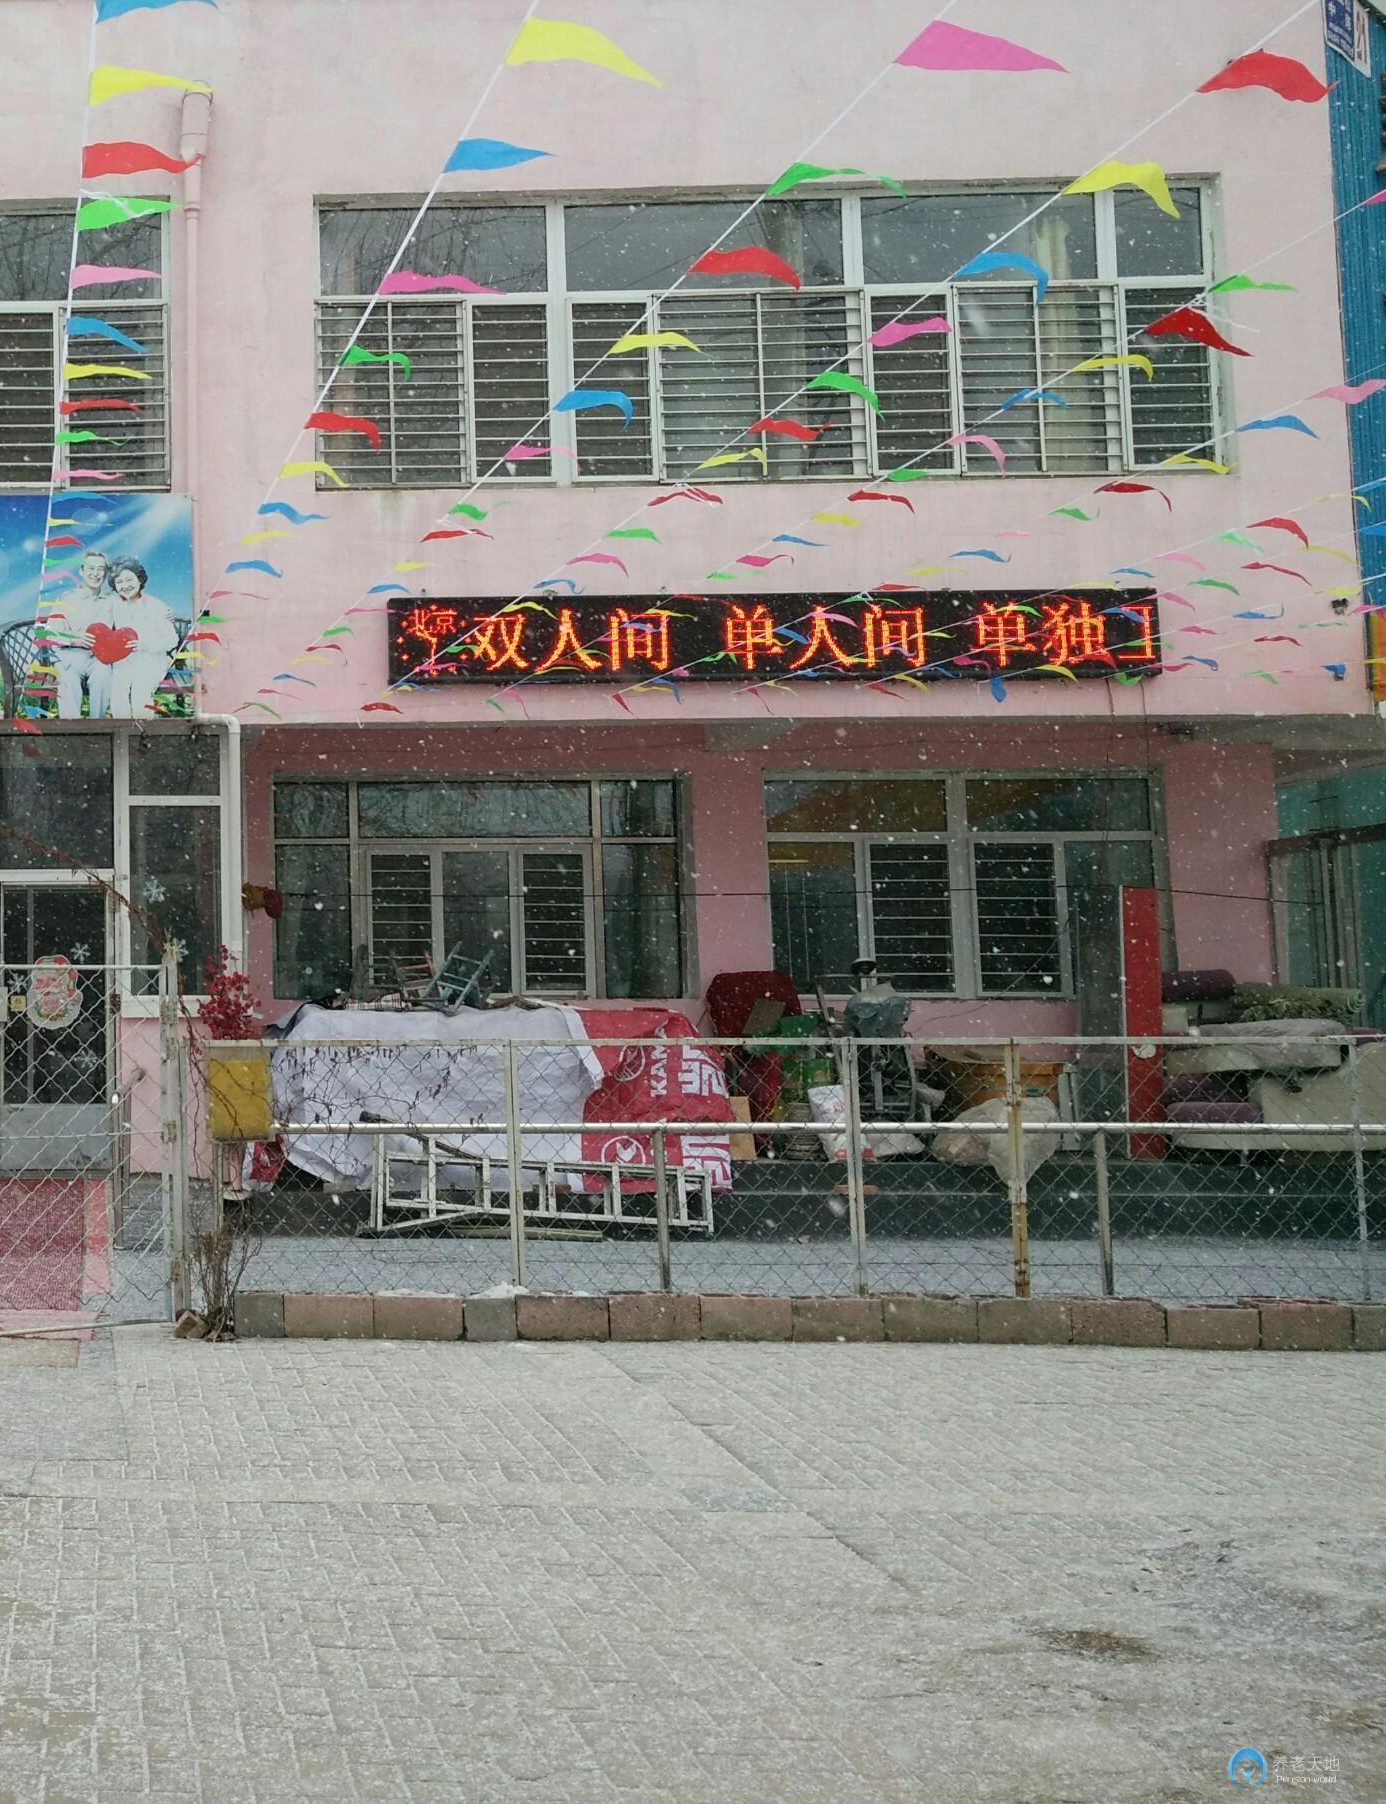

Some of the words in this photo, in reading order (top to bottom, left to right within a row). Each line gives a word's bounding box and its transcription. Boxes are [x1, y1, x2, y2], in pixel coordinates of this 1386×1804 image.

[473, 606, 671, 672] 双人间
[725, 603, 927, 670] 单人间
